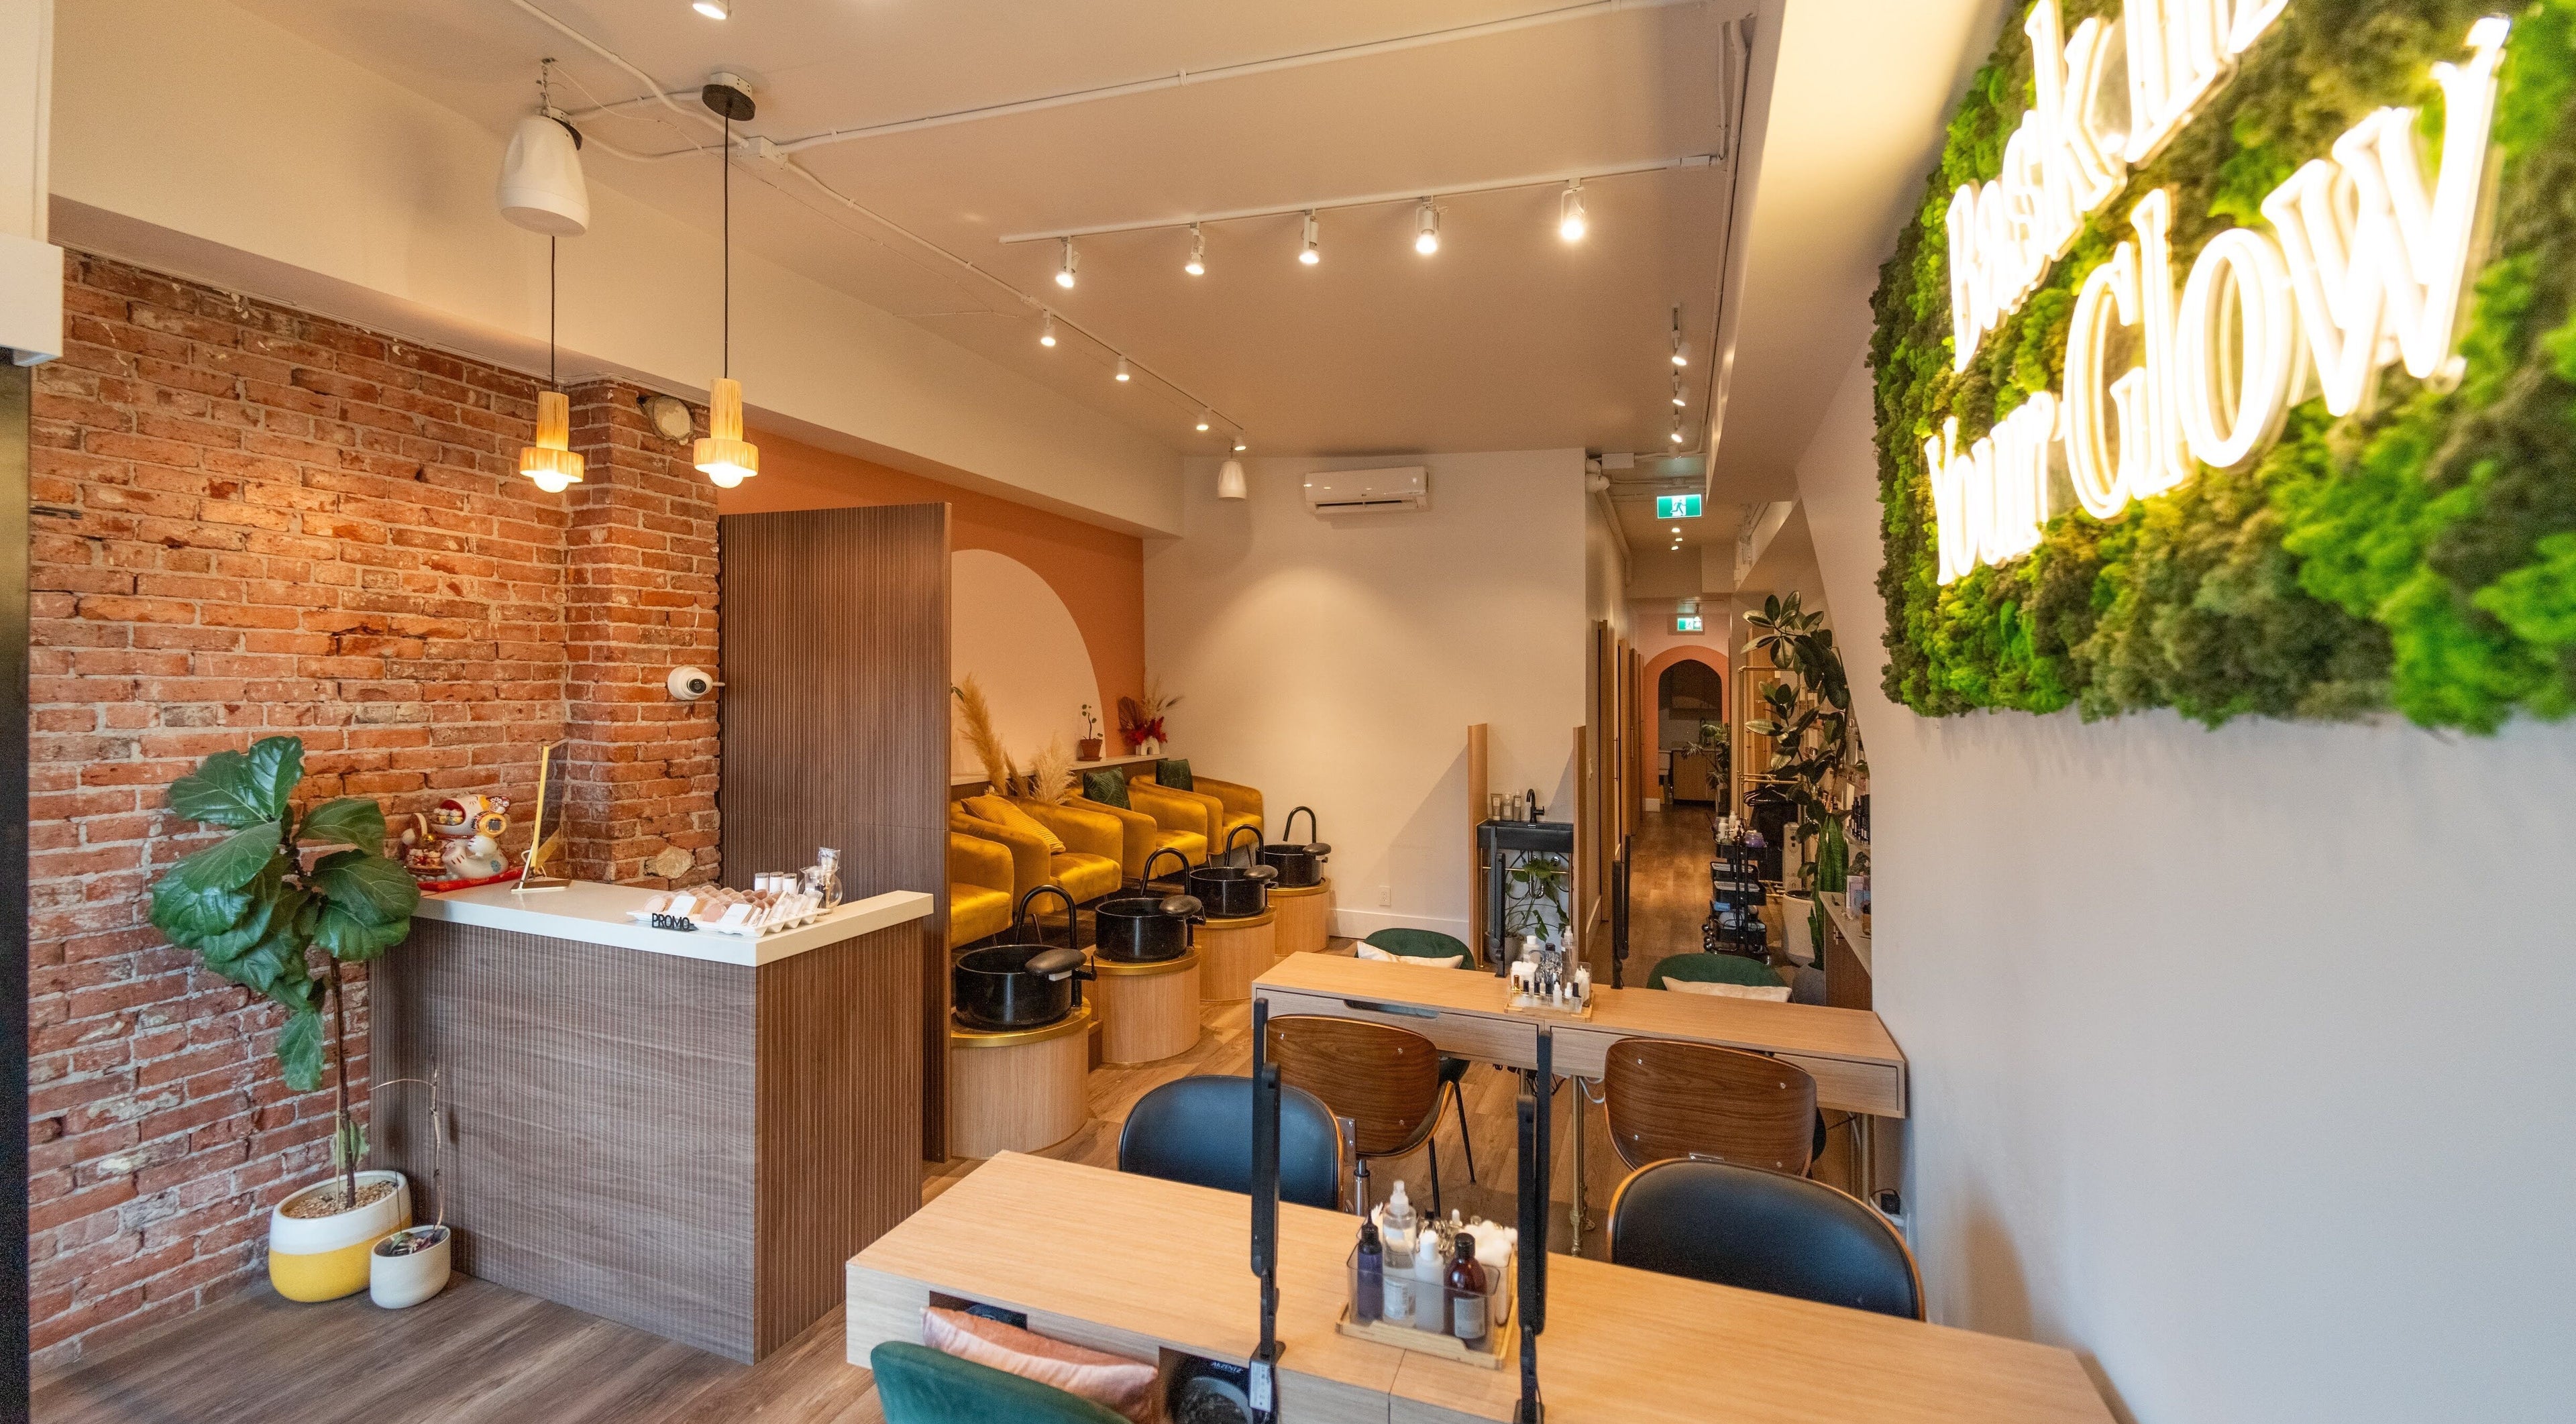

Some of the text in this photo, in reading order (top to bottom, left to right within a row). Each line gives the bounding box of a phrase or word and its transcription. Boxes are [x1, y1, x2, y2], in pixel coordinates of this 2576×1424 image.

[1924, 15, 2510, 586] Your Glow
[1945, 0, 2116, 374] Bask
[651, 913, 690, 930] PROMO
